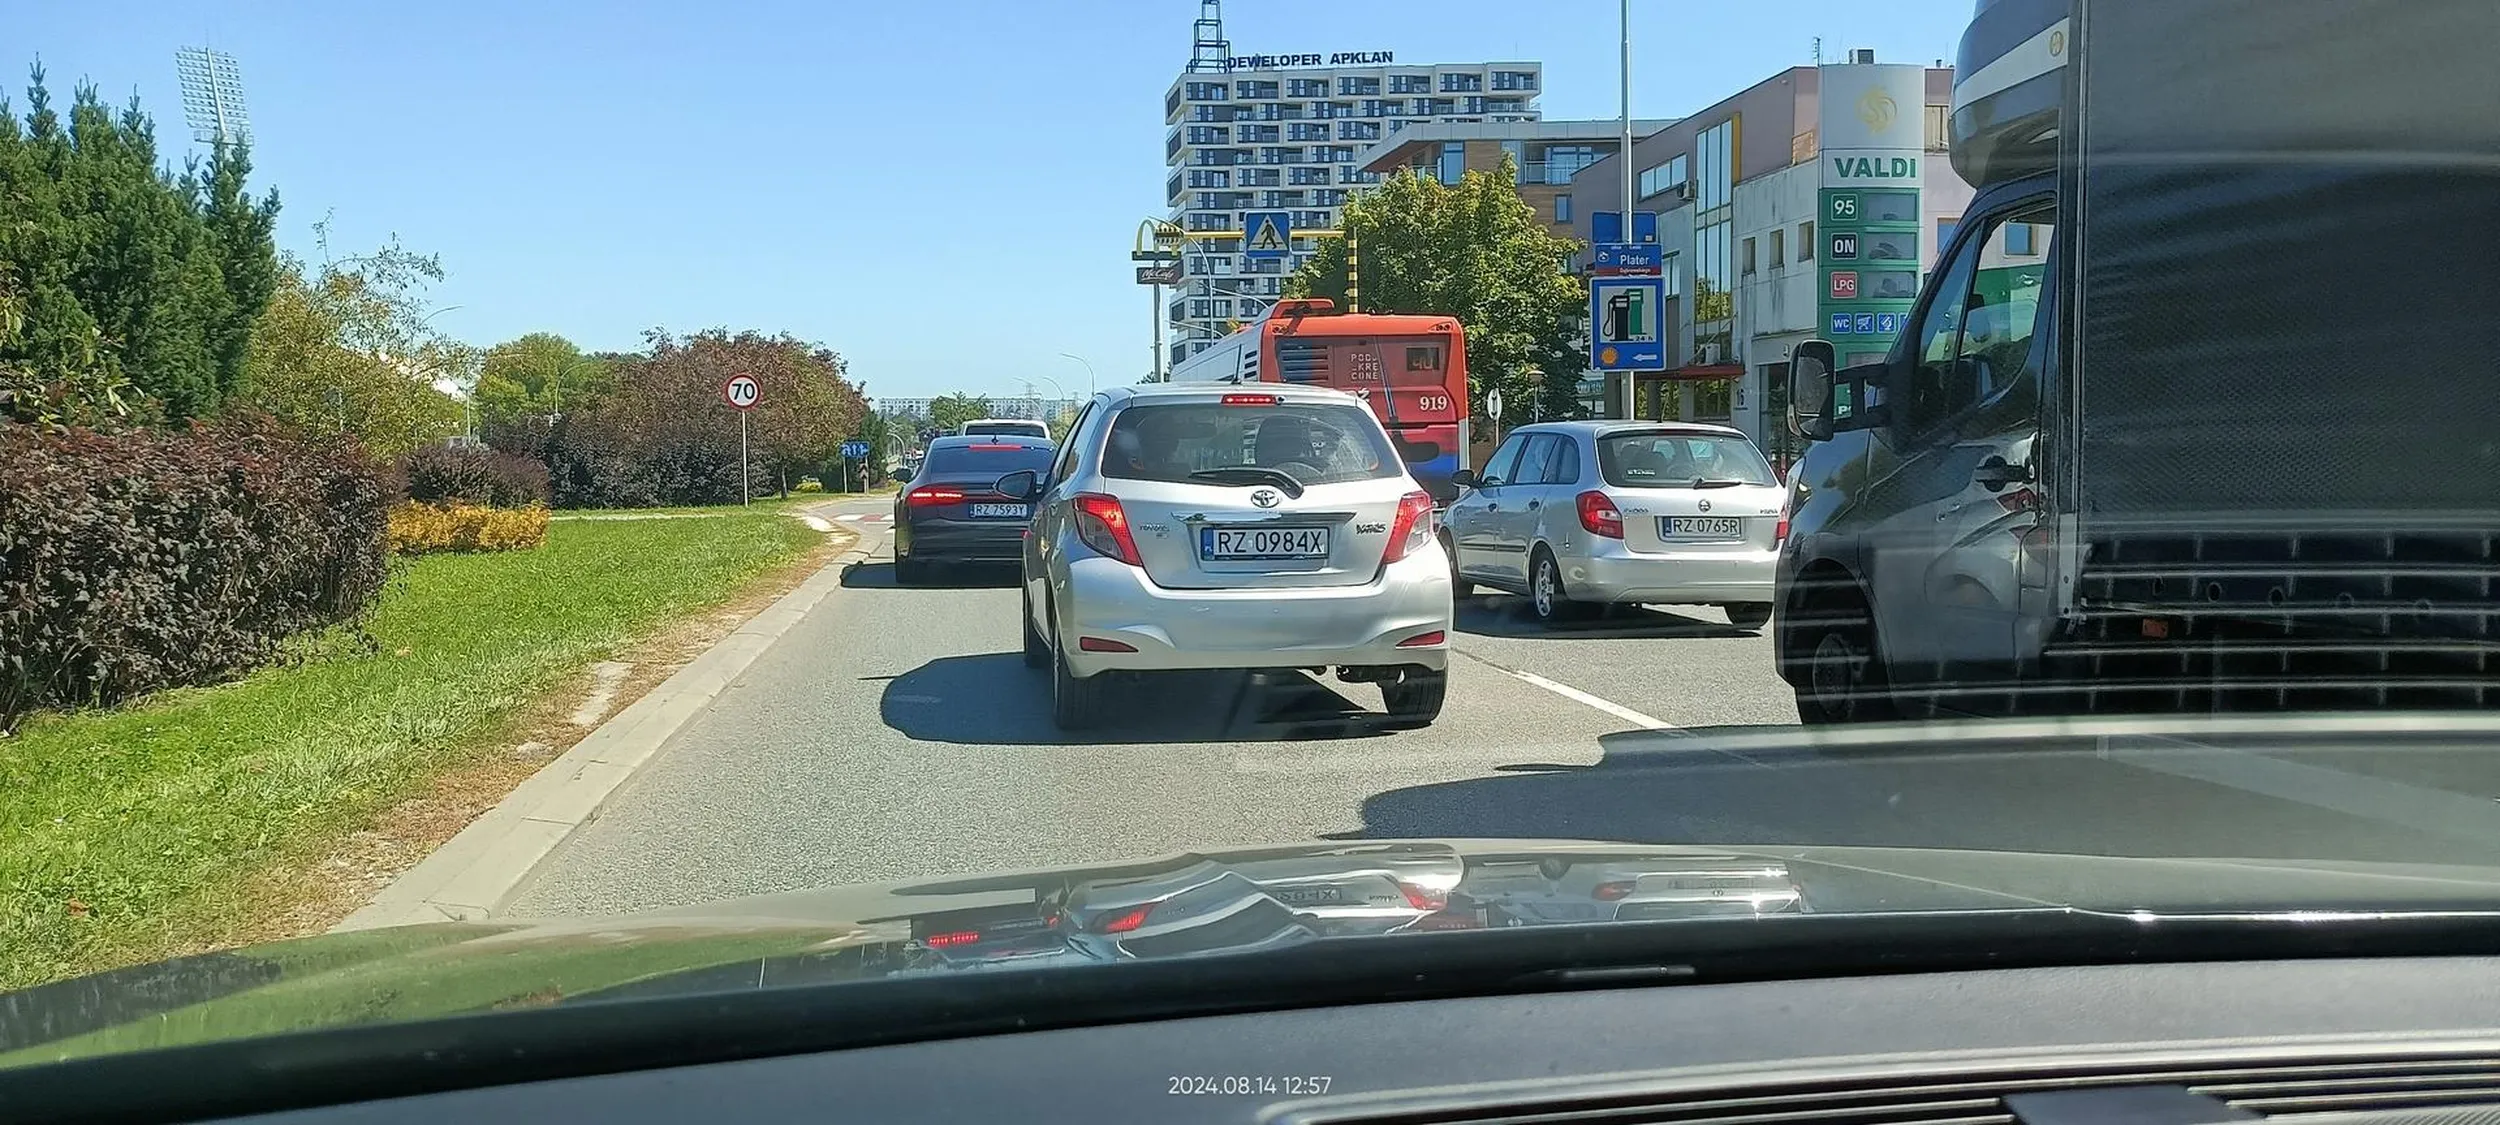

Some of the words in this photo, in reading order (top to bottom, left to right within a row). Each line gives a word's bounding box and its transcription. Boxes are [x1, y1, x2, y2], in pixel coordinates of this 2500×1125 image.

[1228, 54, 1321, 68] DEWELOPER
[1330, 51, 1393, 64] APKLAN
[1834, 157, 1916, 177] VALDI
[1834, 200, 1855, 215] 95
[1834, 239, 1855, 253] ON
[1620, 254, 1649, 265] Plater
[1833, 280, 1855, 291] LPG
[1833, 319, 1850, 328] WC
[1351, 372, 1378, 380] CONE
[732, 383, 755, 400] 70
[1420, 396, 1447, 411] 919
[976, 504, 990, 515] RZ
[994, 504, 1024, 515] 7593Y
[1673, 520, 1692, 532] RZ
[1697, 520, 1738, 532] 0765R
[1218, 532, 1246, 553] RZ
[1255, 531, 1321, 553] 0984X
